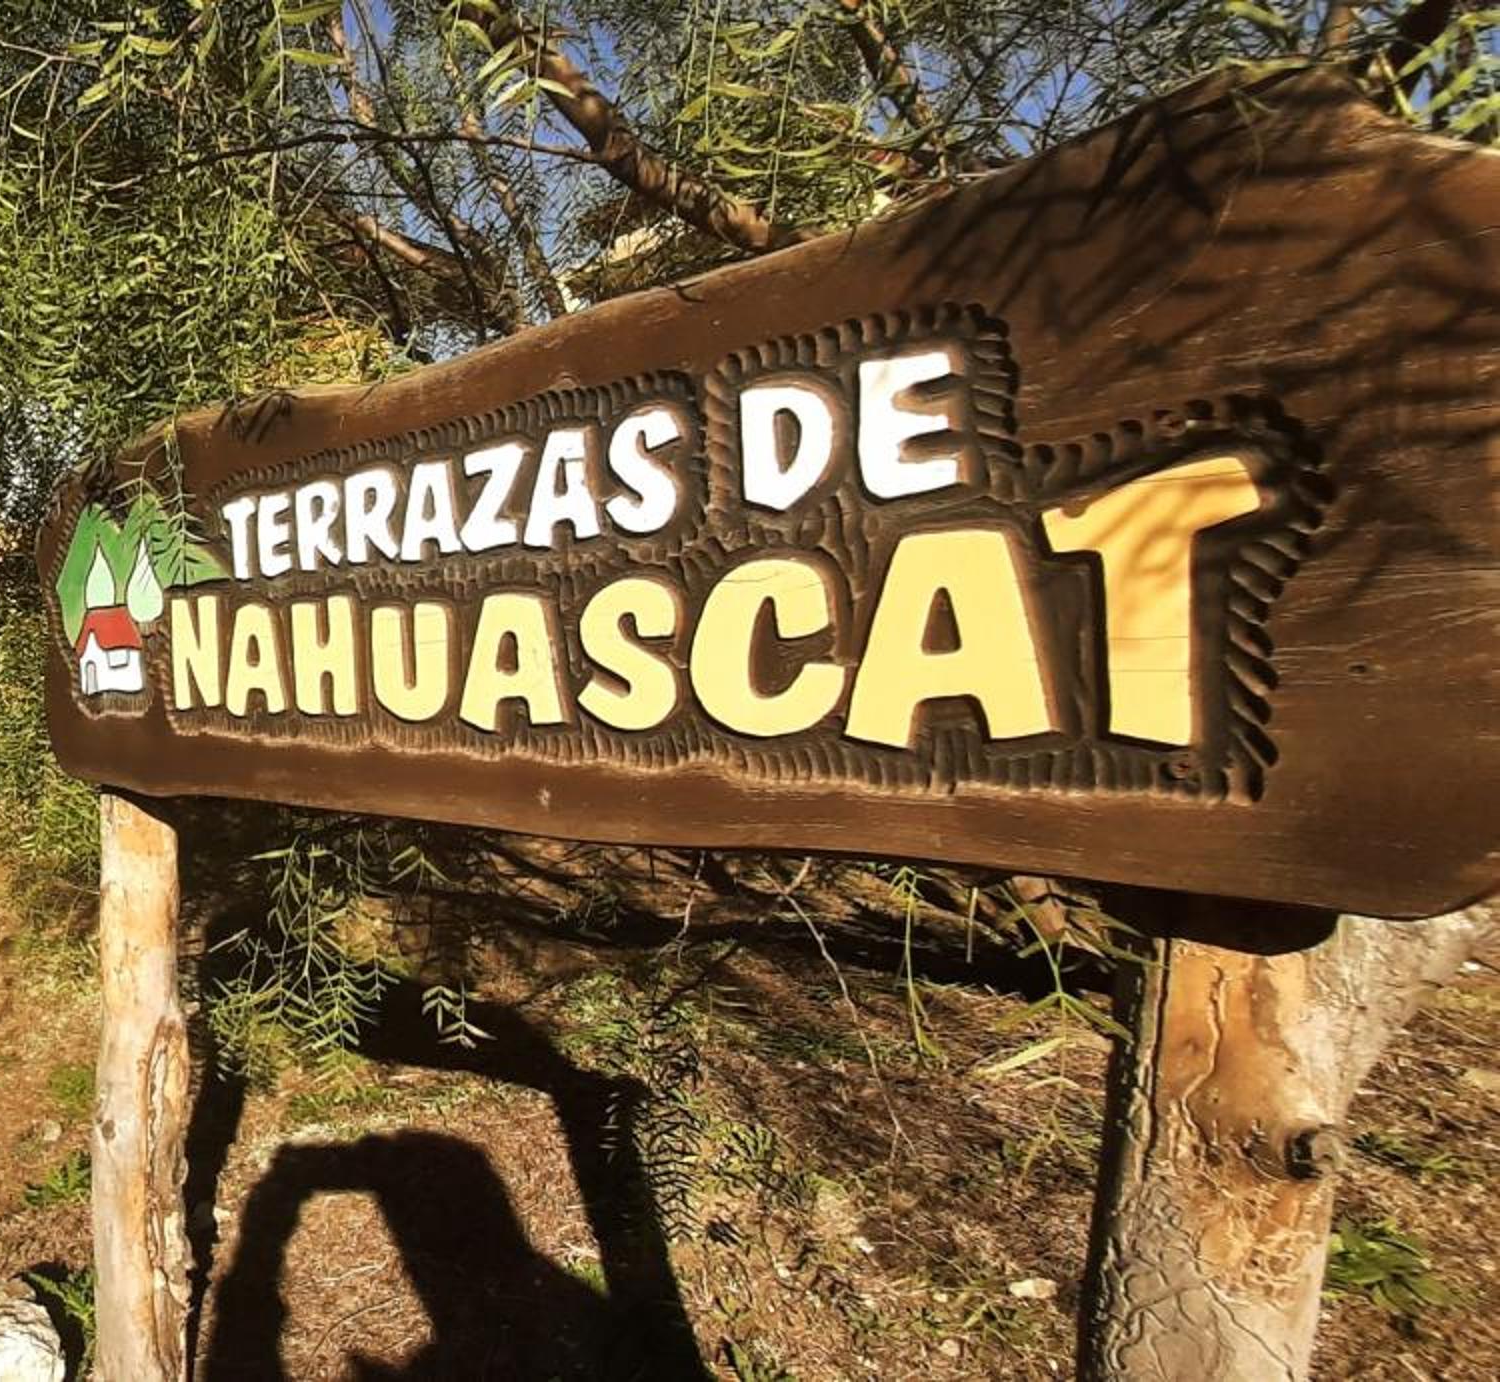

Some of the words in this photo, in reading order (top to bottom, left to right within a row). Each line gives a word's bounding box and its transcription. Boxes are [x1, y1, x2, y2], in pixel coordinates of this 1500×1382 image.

[222, 407, 681, 580] TERRAZAS
[740, 352, 958, 511] DE
[170, 457, 1261, 749] NAHUASCAT
